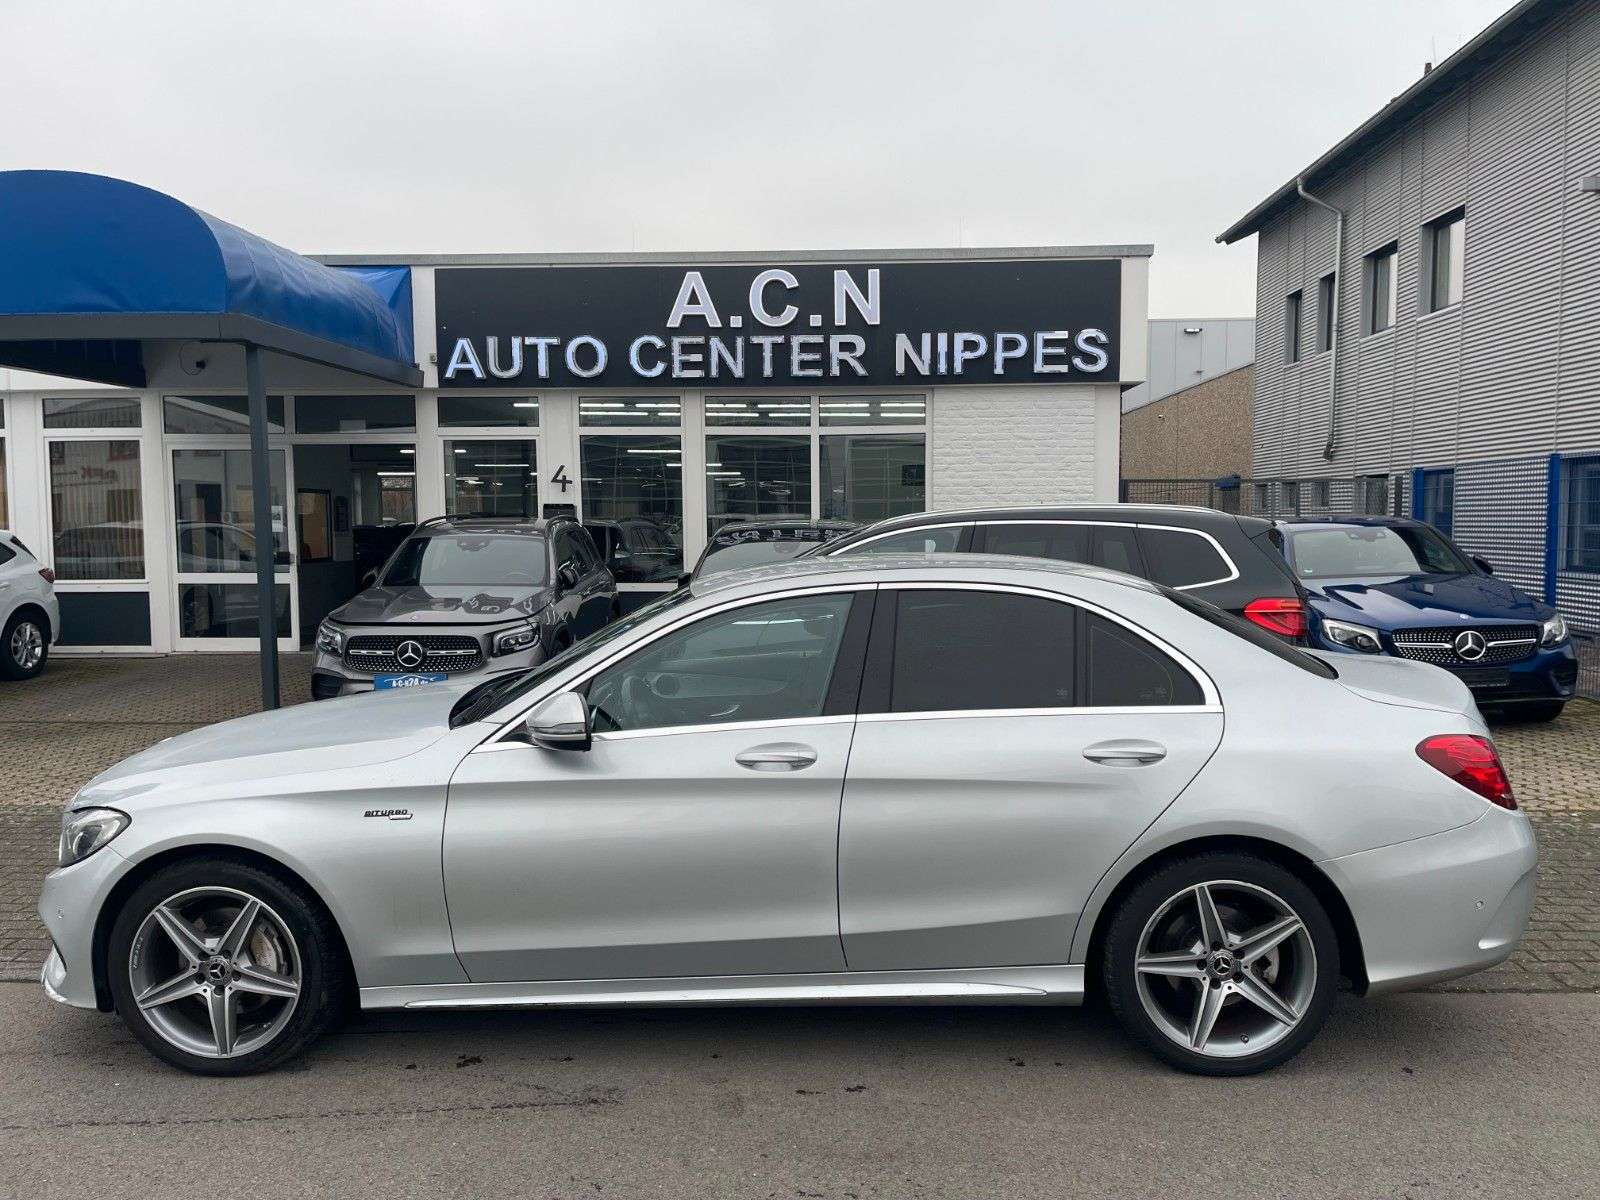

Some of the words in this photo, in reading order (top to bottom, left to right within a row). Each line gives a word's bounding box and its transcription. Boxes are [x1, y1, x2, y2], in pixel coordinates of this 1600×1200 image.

[666, 268, 881, 328] A.C.N
[444, 334, 609, 379] AUTO
[628, 334, 869, 379] CENTER
[895, 328, 1109, 377] NIPPES
[550, 464, 573, 492] 4
[363, 809, 408, 817] BITURBO
